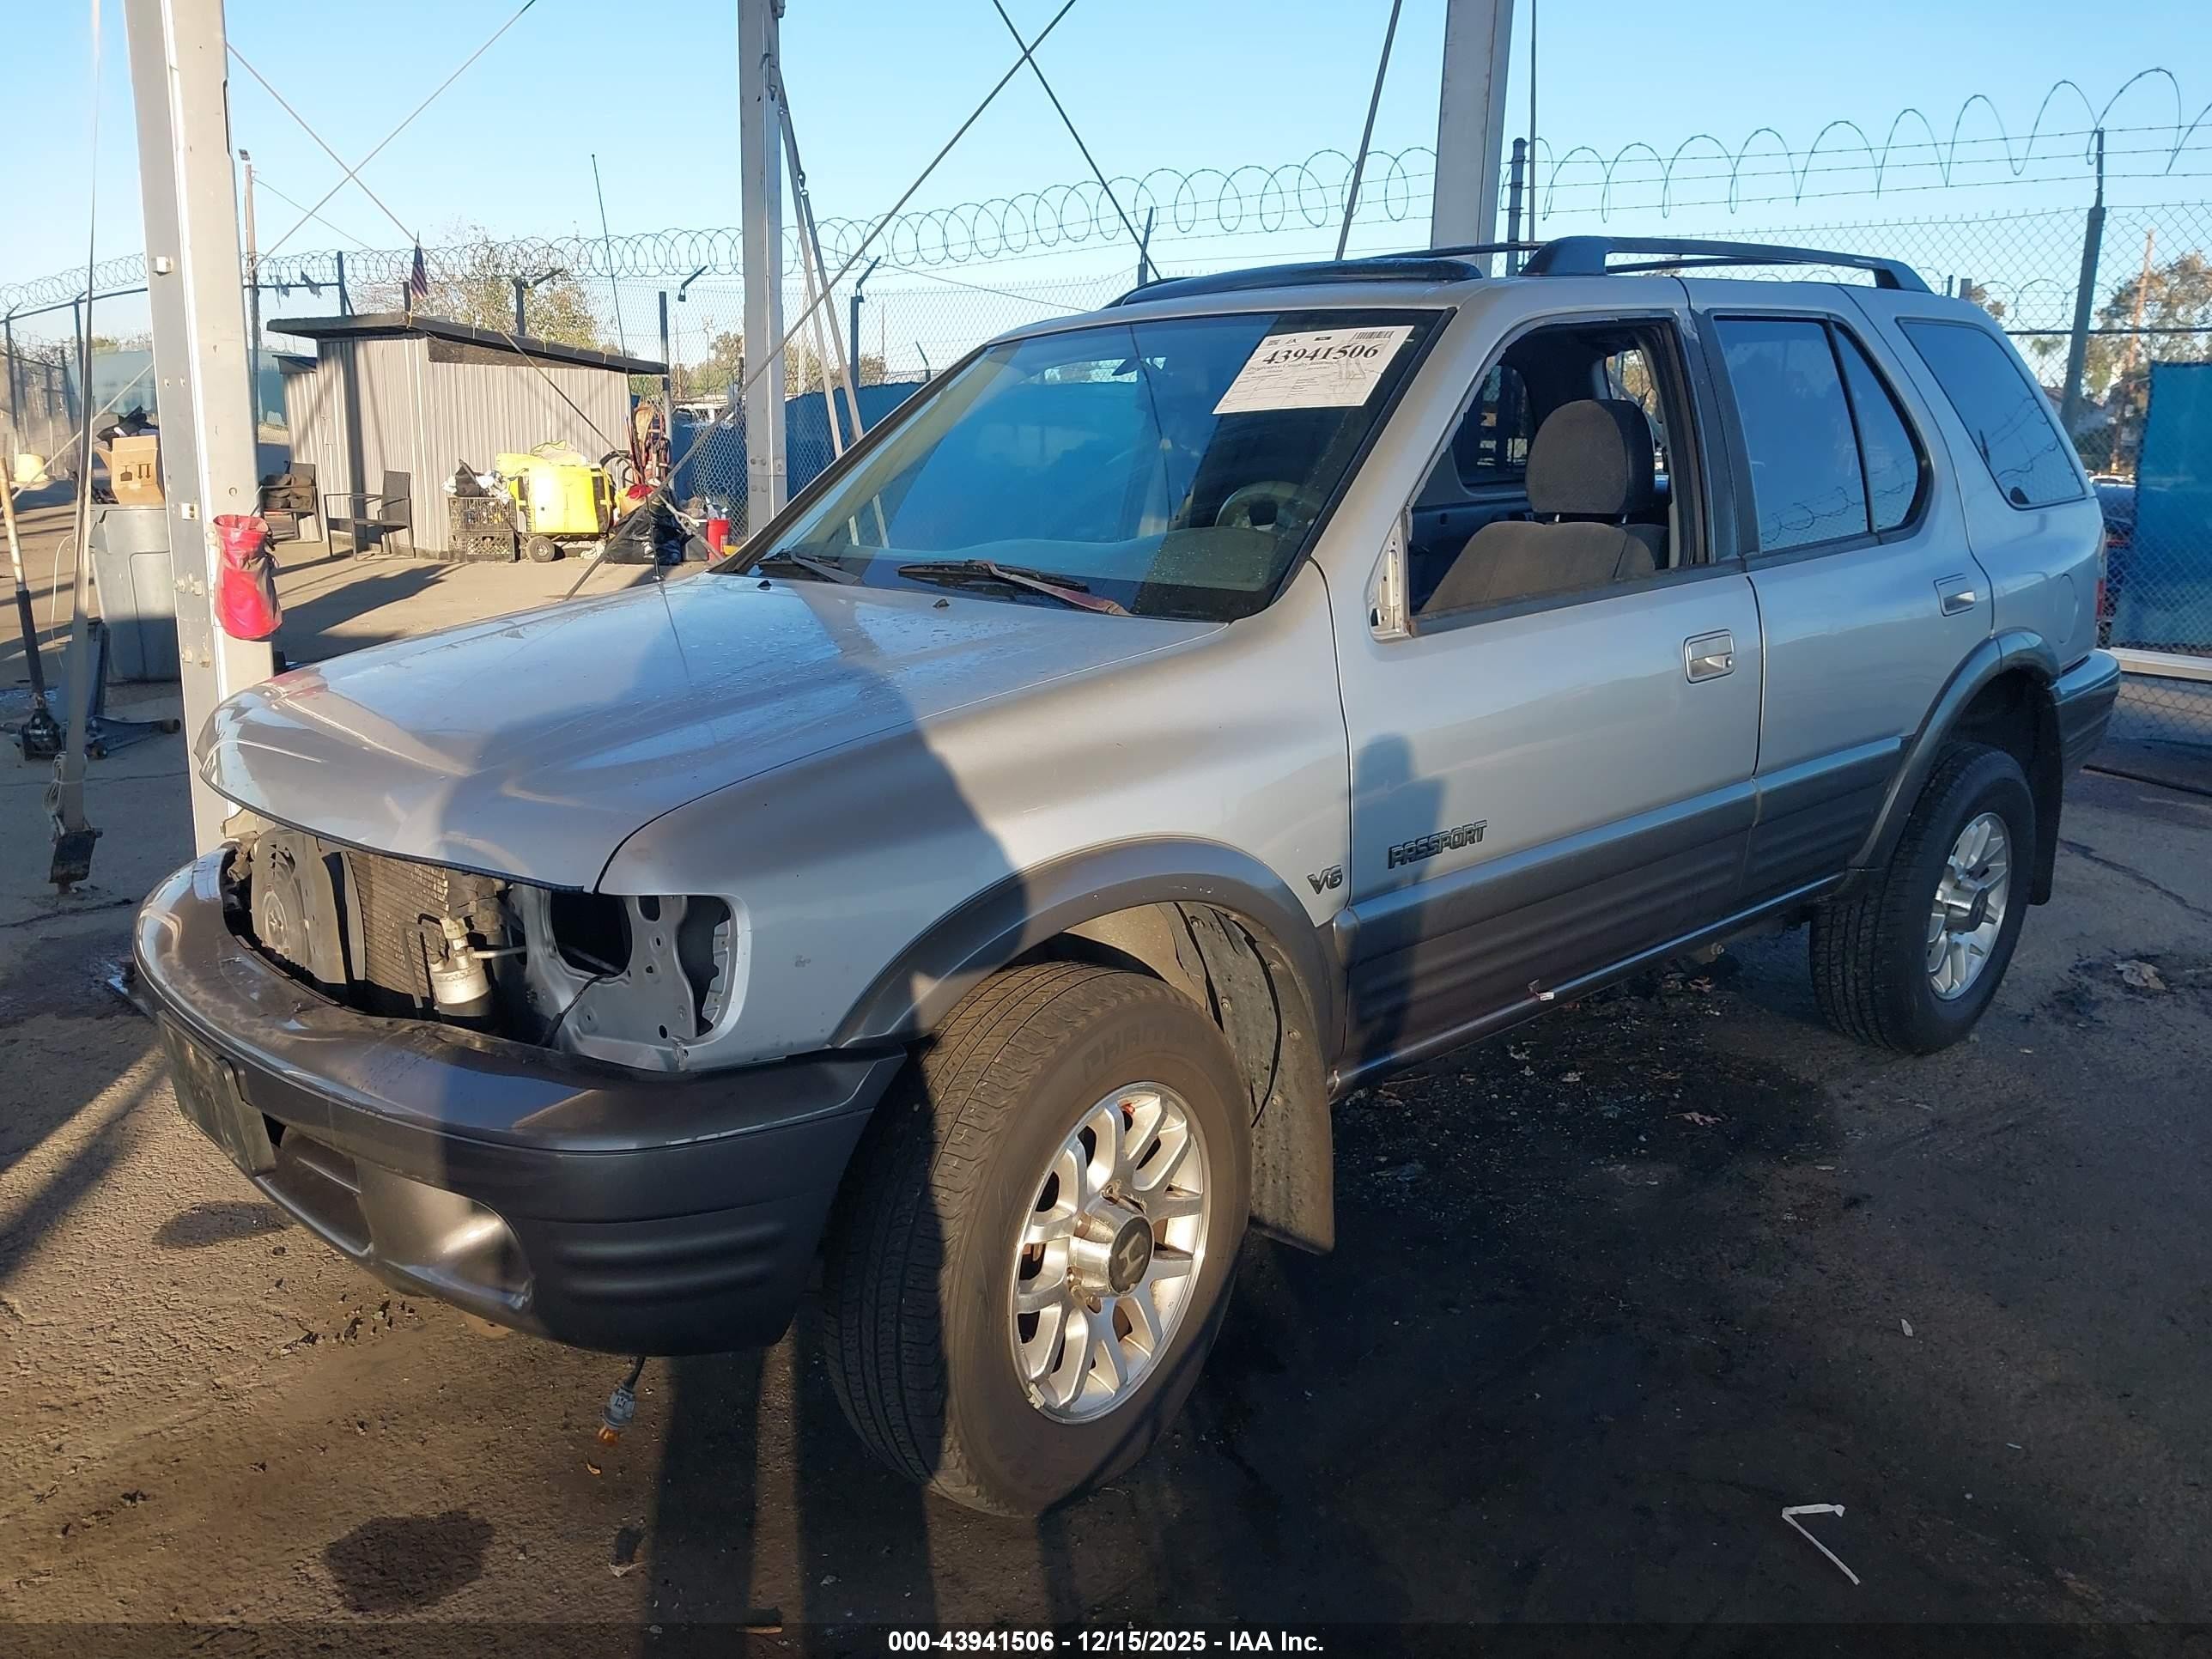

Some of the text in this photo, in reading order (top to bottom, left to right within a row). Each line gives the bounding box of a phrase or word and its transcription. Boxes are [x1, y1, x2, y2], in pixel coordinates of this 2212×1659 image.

[1262, 343, 1382, 365] 43941506
[1388, 819, 1487, 869] PASSPORT
[1308, 865, 1343, 895] V6
